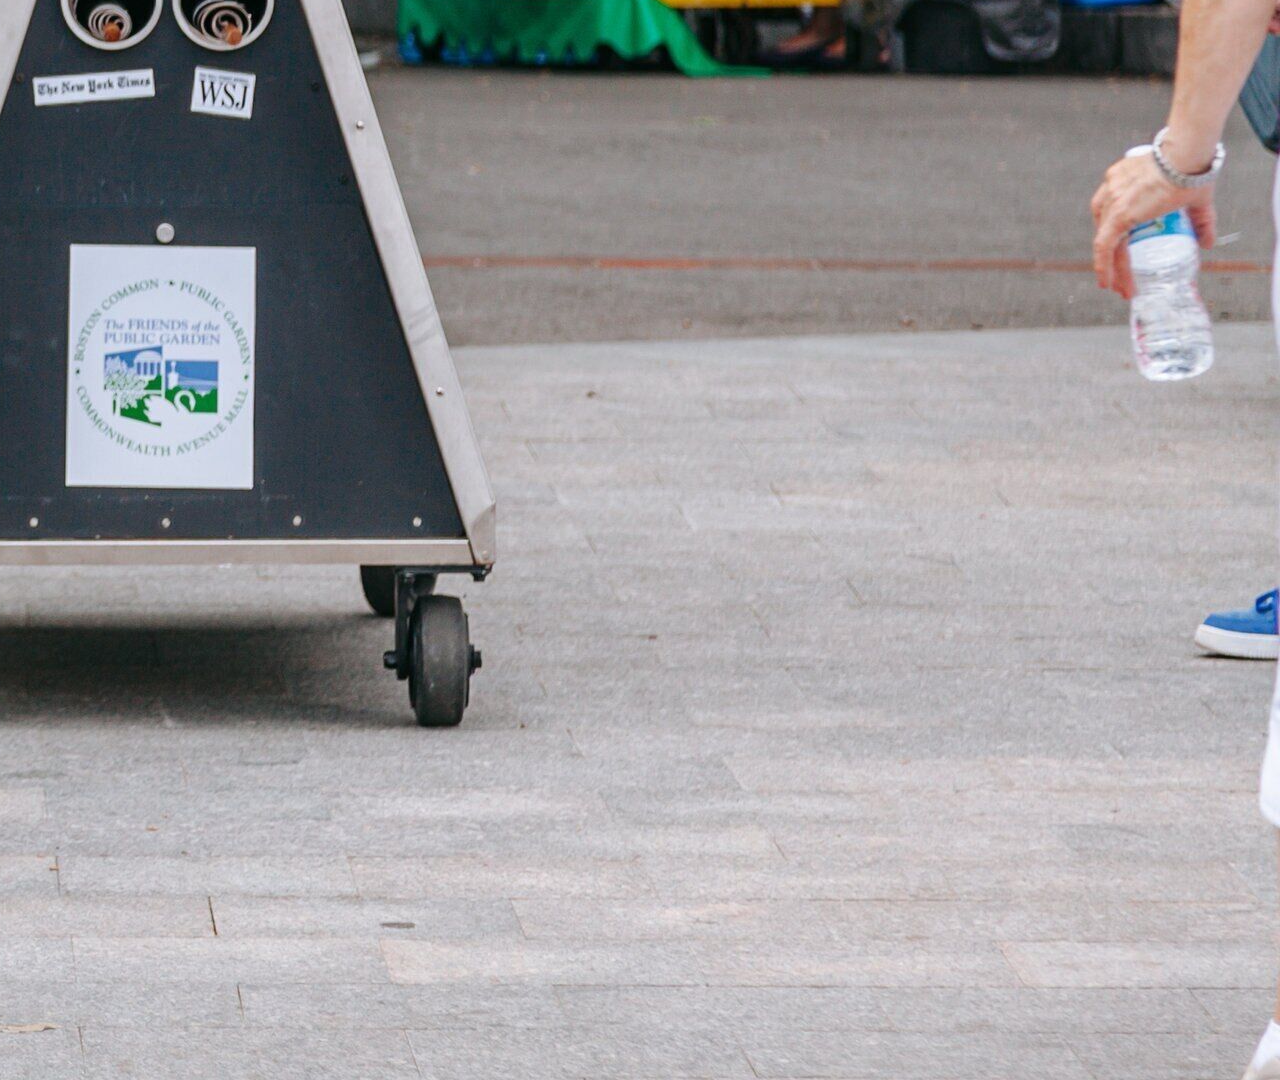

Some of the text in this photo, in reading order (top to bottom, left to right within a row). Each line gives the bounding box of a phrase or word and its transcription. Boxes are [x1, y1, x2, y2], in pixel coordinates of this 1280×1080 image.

[37, 76, 151, 95] The New York Times
[199, 79, 248, 111] WSJ
[74, 278, 252, 366] BOSTON COMMON PUBLIC GARDEN
[104, 318, 221, 332] The FRIENDS of the
[104, 332, 221, 346] PUBLIC GARDEN
[76, 385, 248, 457] COMMONWEALTH AVENUE MALL
